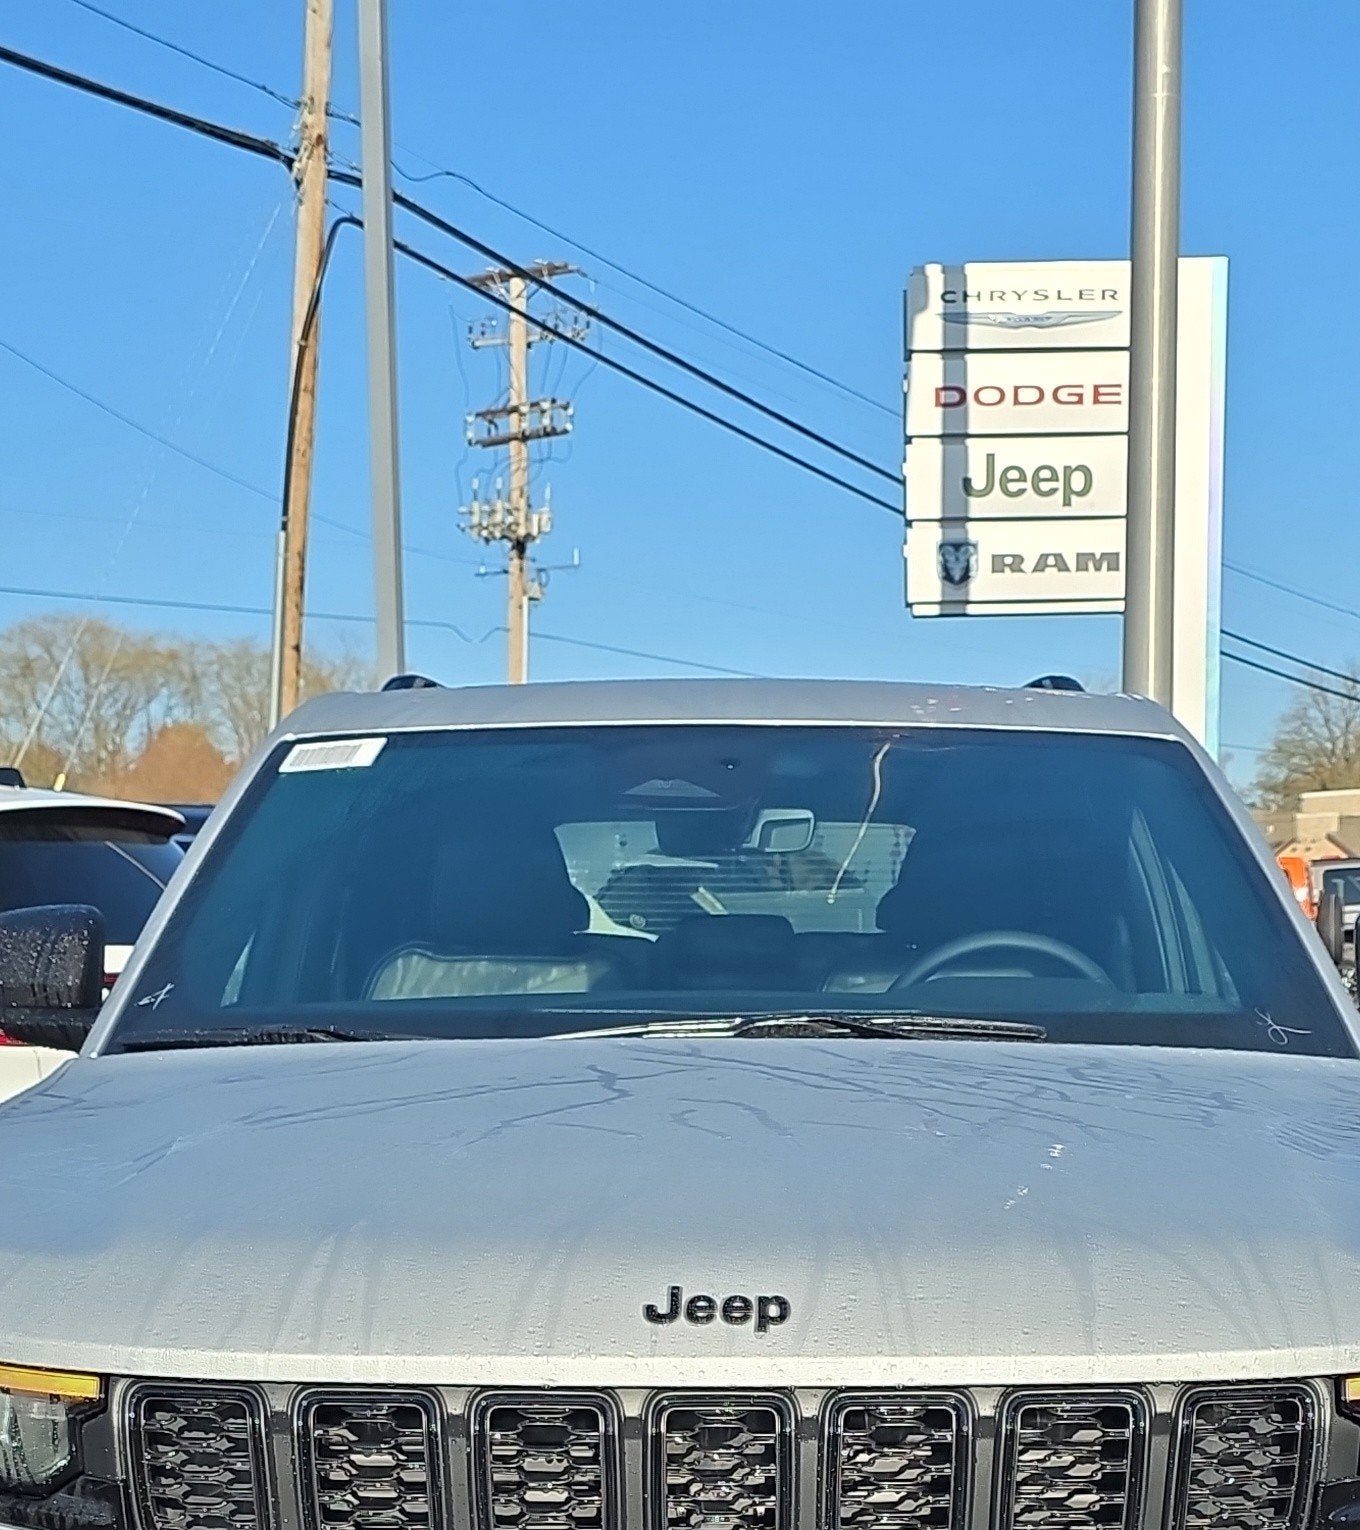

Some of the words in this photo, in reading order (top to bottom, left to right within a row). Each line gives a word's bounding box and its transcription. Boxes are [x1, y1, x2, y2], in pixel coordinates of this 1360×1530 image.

[940, 288, 1119, 303] CHRYSLER
[934, 384, 1122, 408] DODGE
[963, 453, 1093, 506] Jeep
[991, 551, 1120, 574] RAM
[643, 1285, 791, 1333] Jeep
